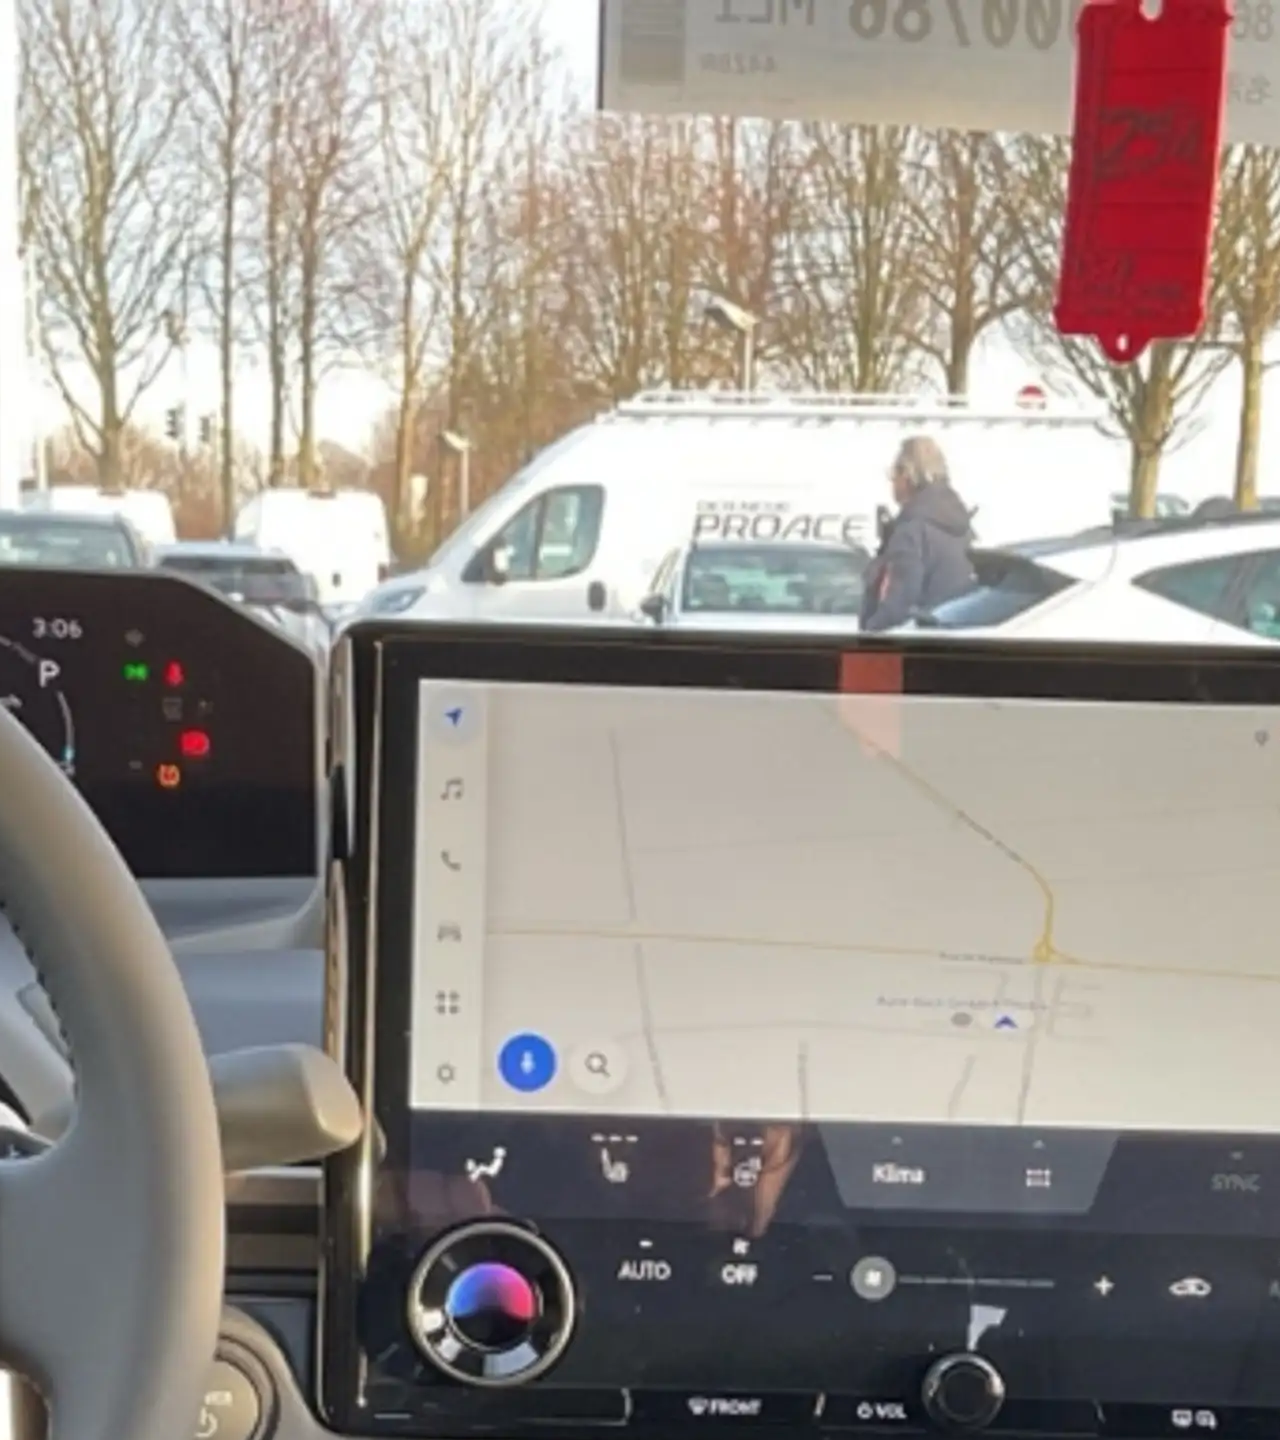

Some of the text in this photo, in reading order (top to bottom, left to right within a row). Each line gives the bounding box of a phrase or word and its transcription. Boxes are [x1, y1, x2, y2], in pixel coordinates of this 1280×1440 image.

[694, 513, 869, 541] PROACE
[32, 617, 84, 640] 3:06
[38, 658, 61, 689] P
[873, 1163, 926, 1184] Klima
[1211, 1173, 1261, 1192] SYNC
[617, 1260, 671, 1282] AUTO
[721, 1263, 759, 1286] OFF
[709, 1399, 762, 1417] FRONT
[875, 1404, 907, 1420] VOL
